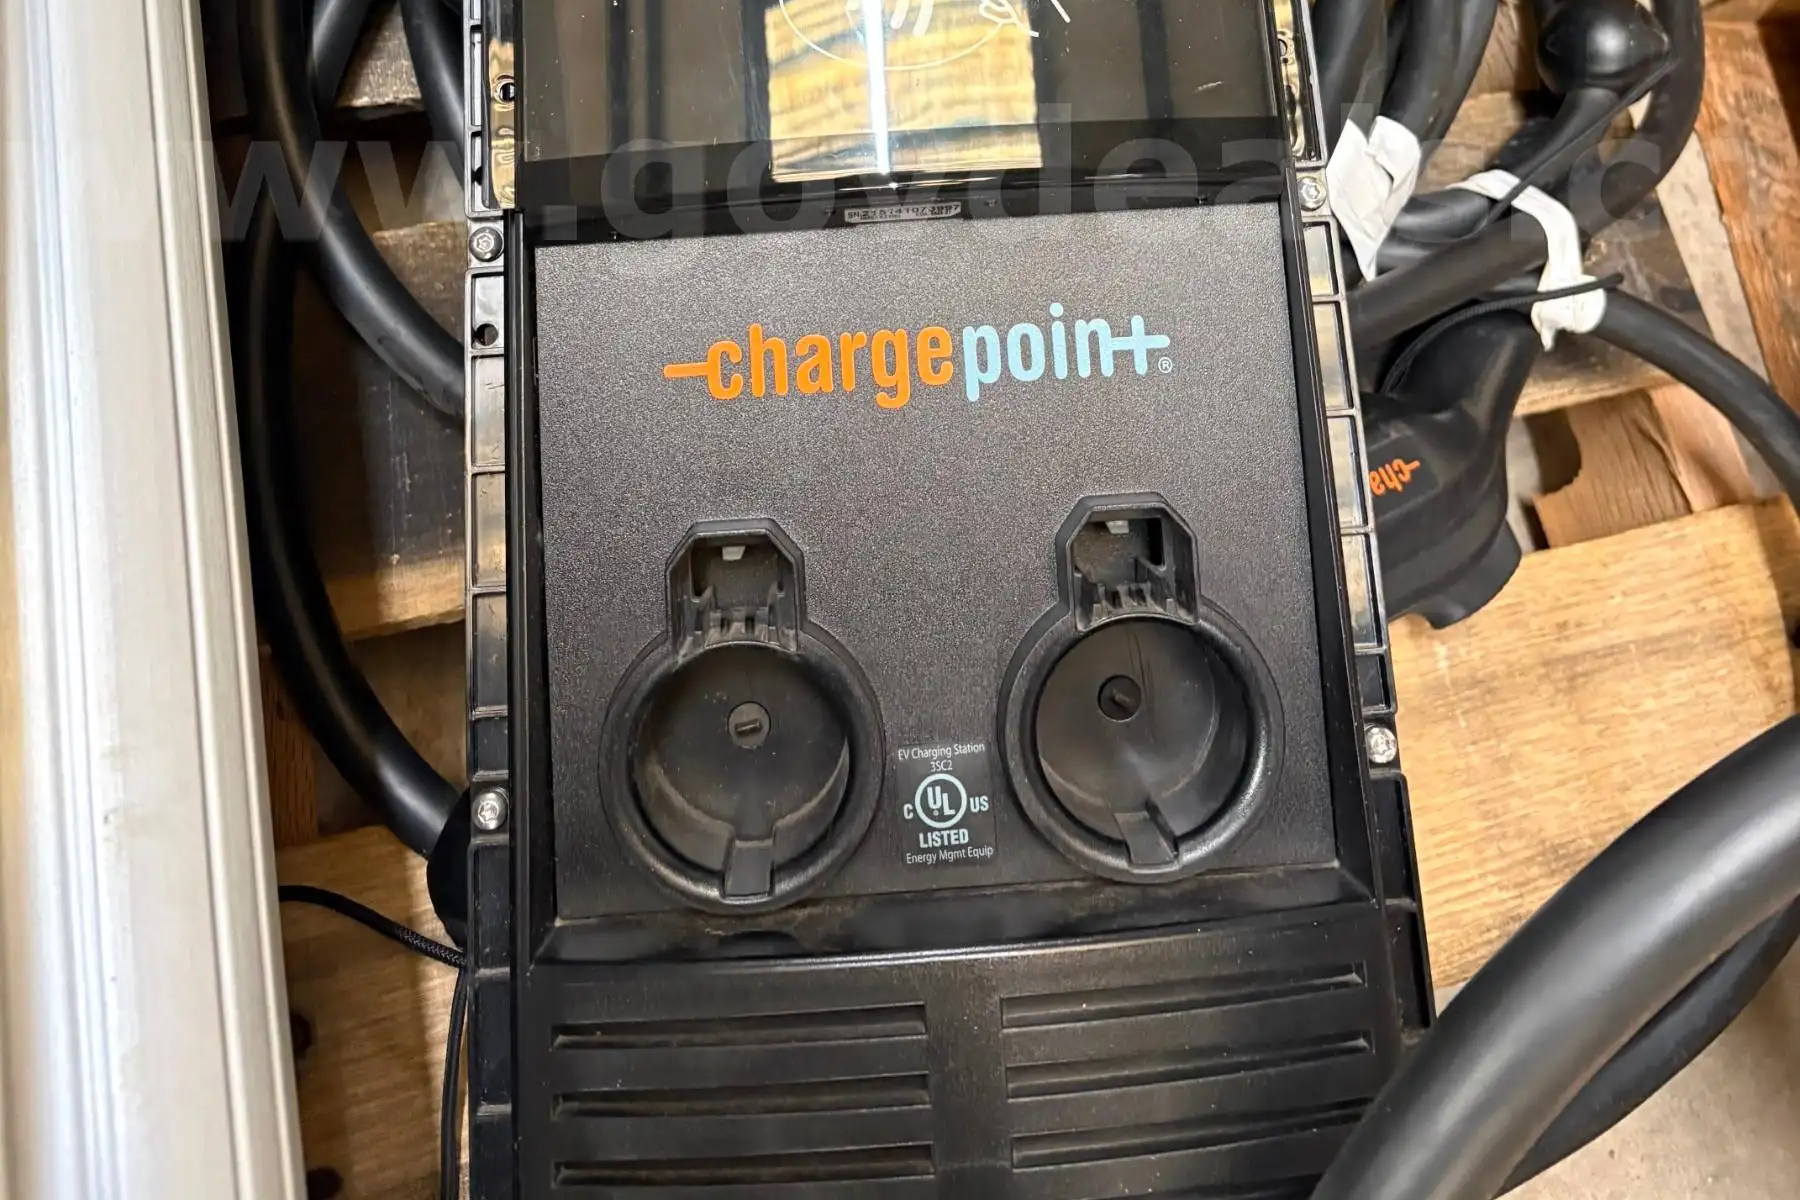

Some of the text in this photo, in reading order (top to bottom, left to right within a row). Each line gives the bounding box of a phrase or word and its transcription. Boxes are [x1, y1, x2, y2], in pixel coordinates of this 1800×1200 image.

[898, 742, 986, 761] EV Charging Station
[969, 795, 989, 813] US
[919, 828, 969, 849] LISTED
[906, 844, 994, 865] Energy Mgmt Equip
